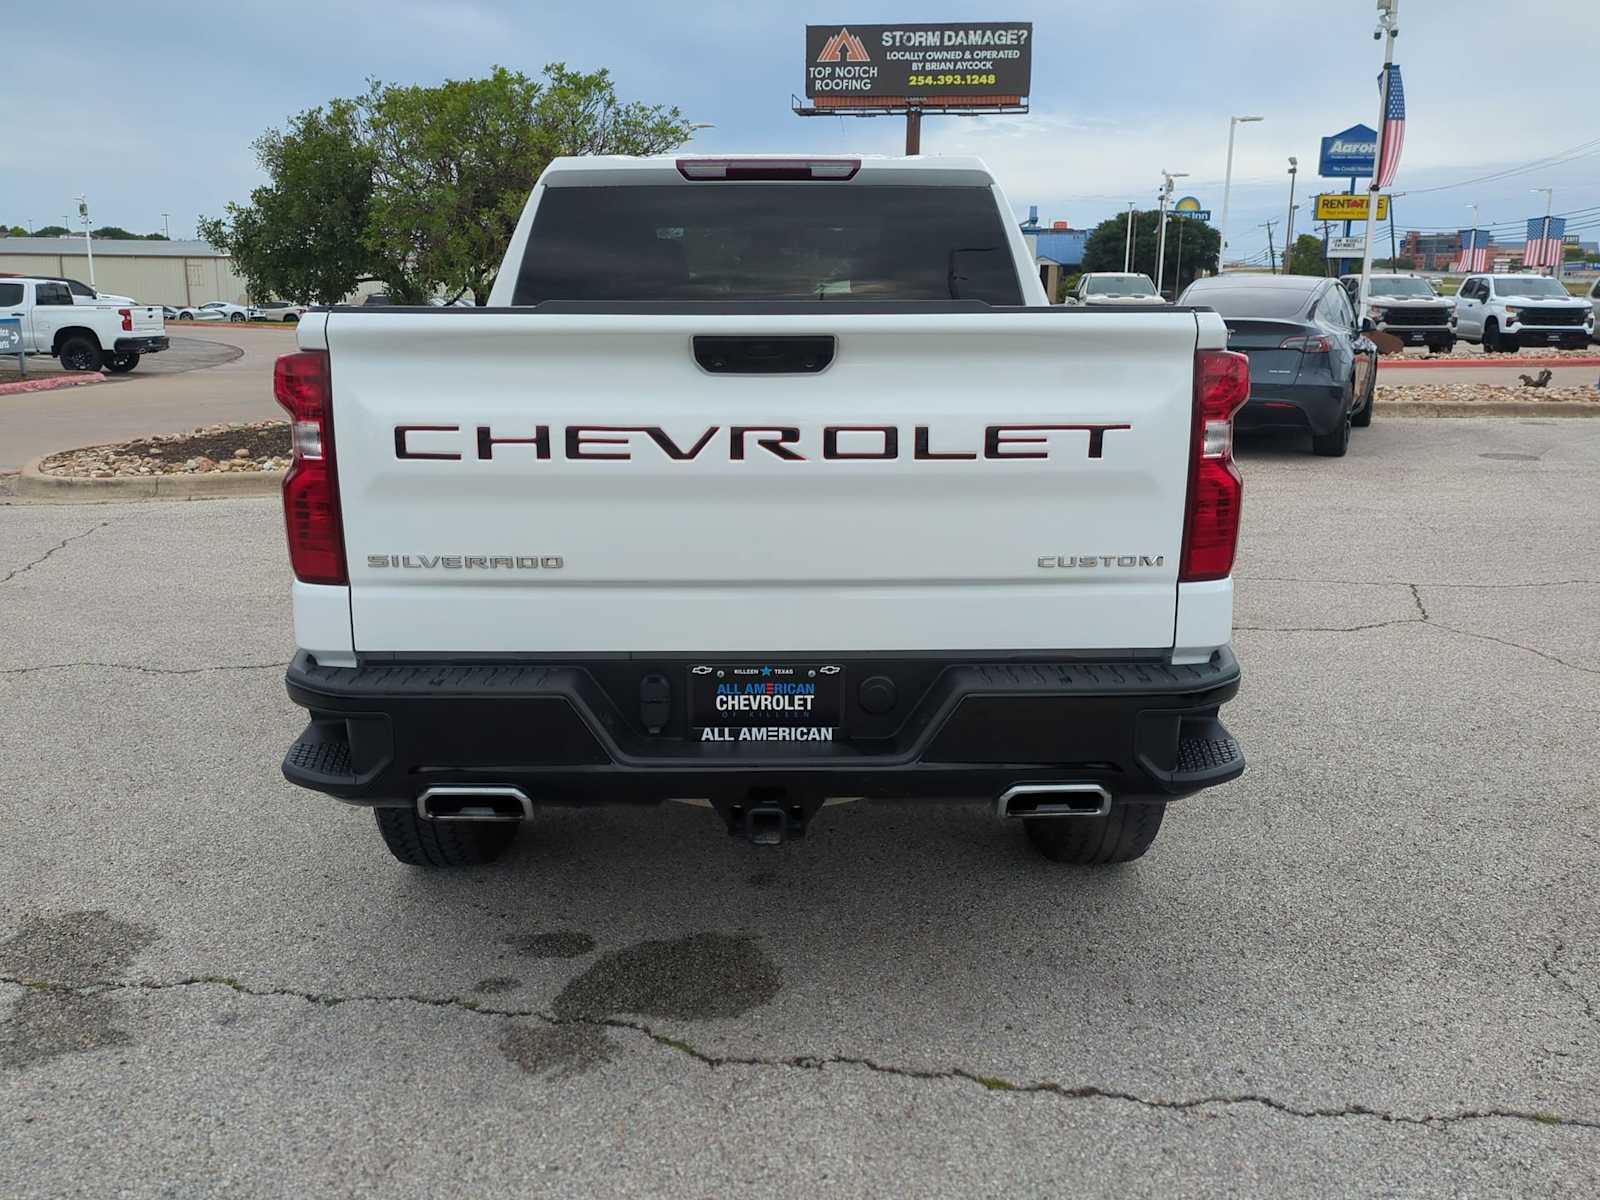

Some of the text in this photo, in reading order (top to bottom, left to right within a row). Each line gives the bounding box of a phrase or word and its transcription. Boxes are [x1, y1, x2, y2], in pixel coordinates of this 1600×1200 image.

[881, 29, 1028, 47] STORM DAMAGE?
[886, 50, 1020, 61] LOCALLY OWNED & OPERATED
[809, 66, 878, 79] TOP NOTCH
[911, 61, 993, 71] BY BRIAN AYCOCK
[815, 79, 872, 91] ROOFING
[908, 74, 996, 86] 254.393.1248
[1322, 199, 1352, 209] RENT
[394, 424, 1132, 461] CHEVROLET
[367, 554, 564, 570] SILVERADO
[1037, 554, 1164, 569] CUSTOM
[717, 683, 815, 694] ALL AMERICAN
[716, 695, 815, 711] CHEVROLET
[701, 727, 833, 741] ALL AMERICAN
